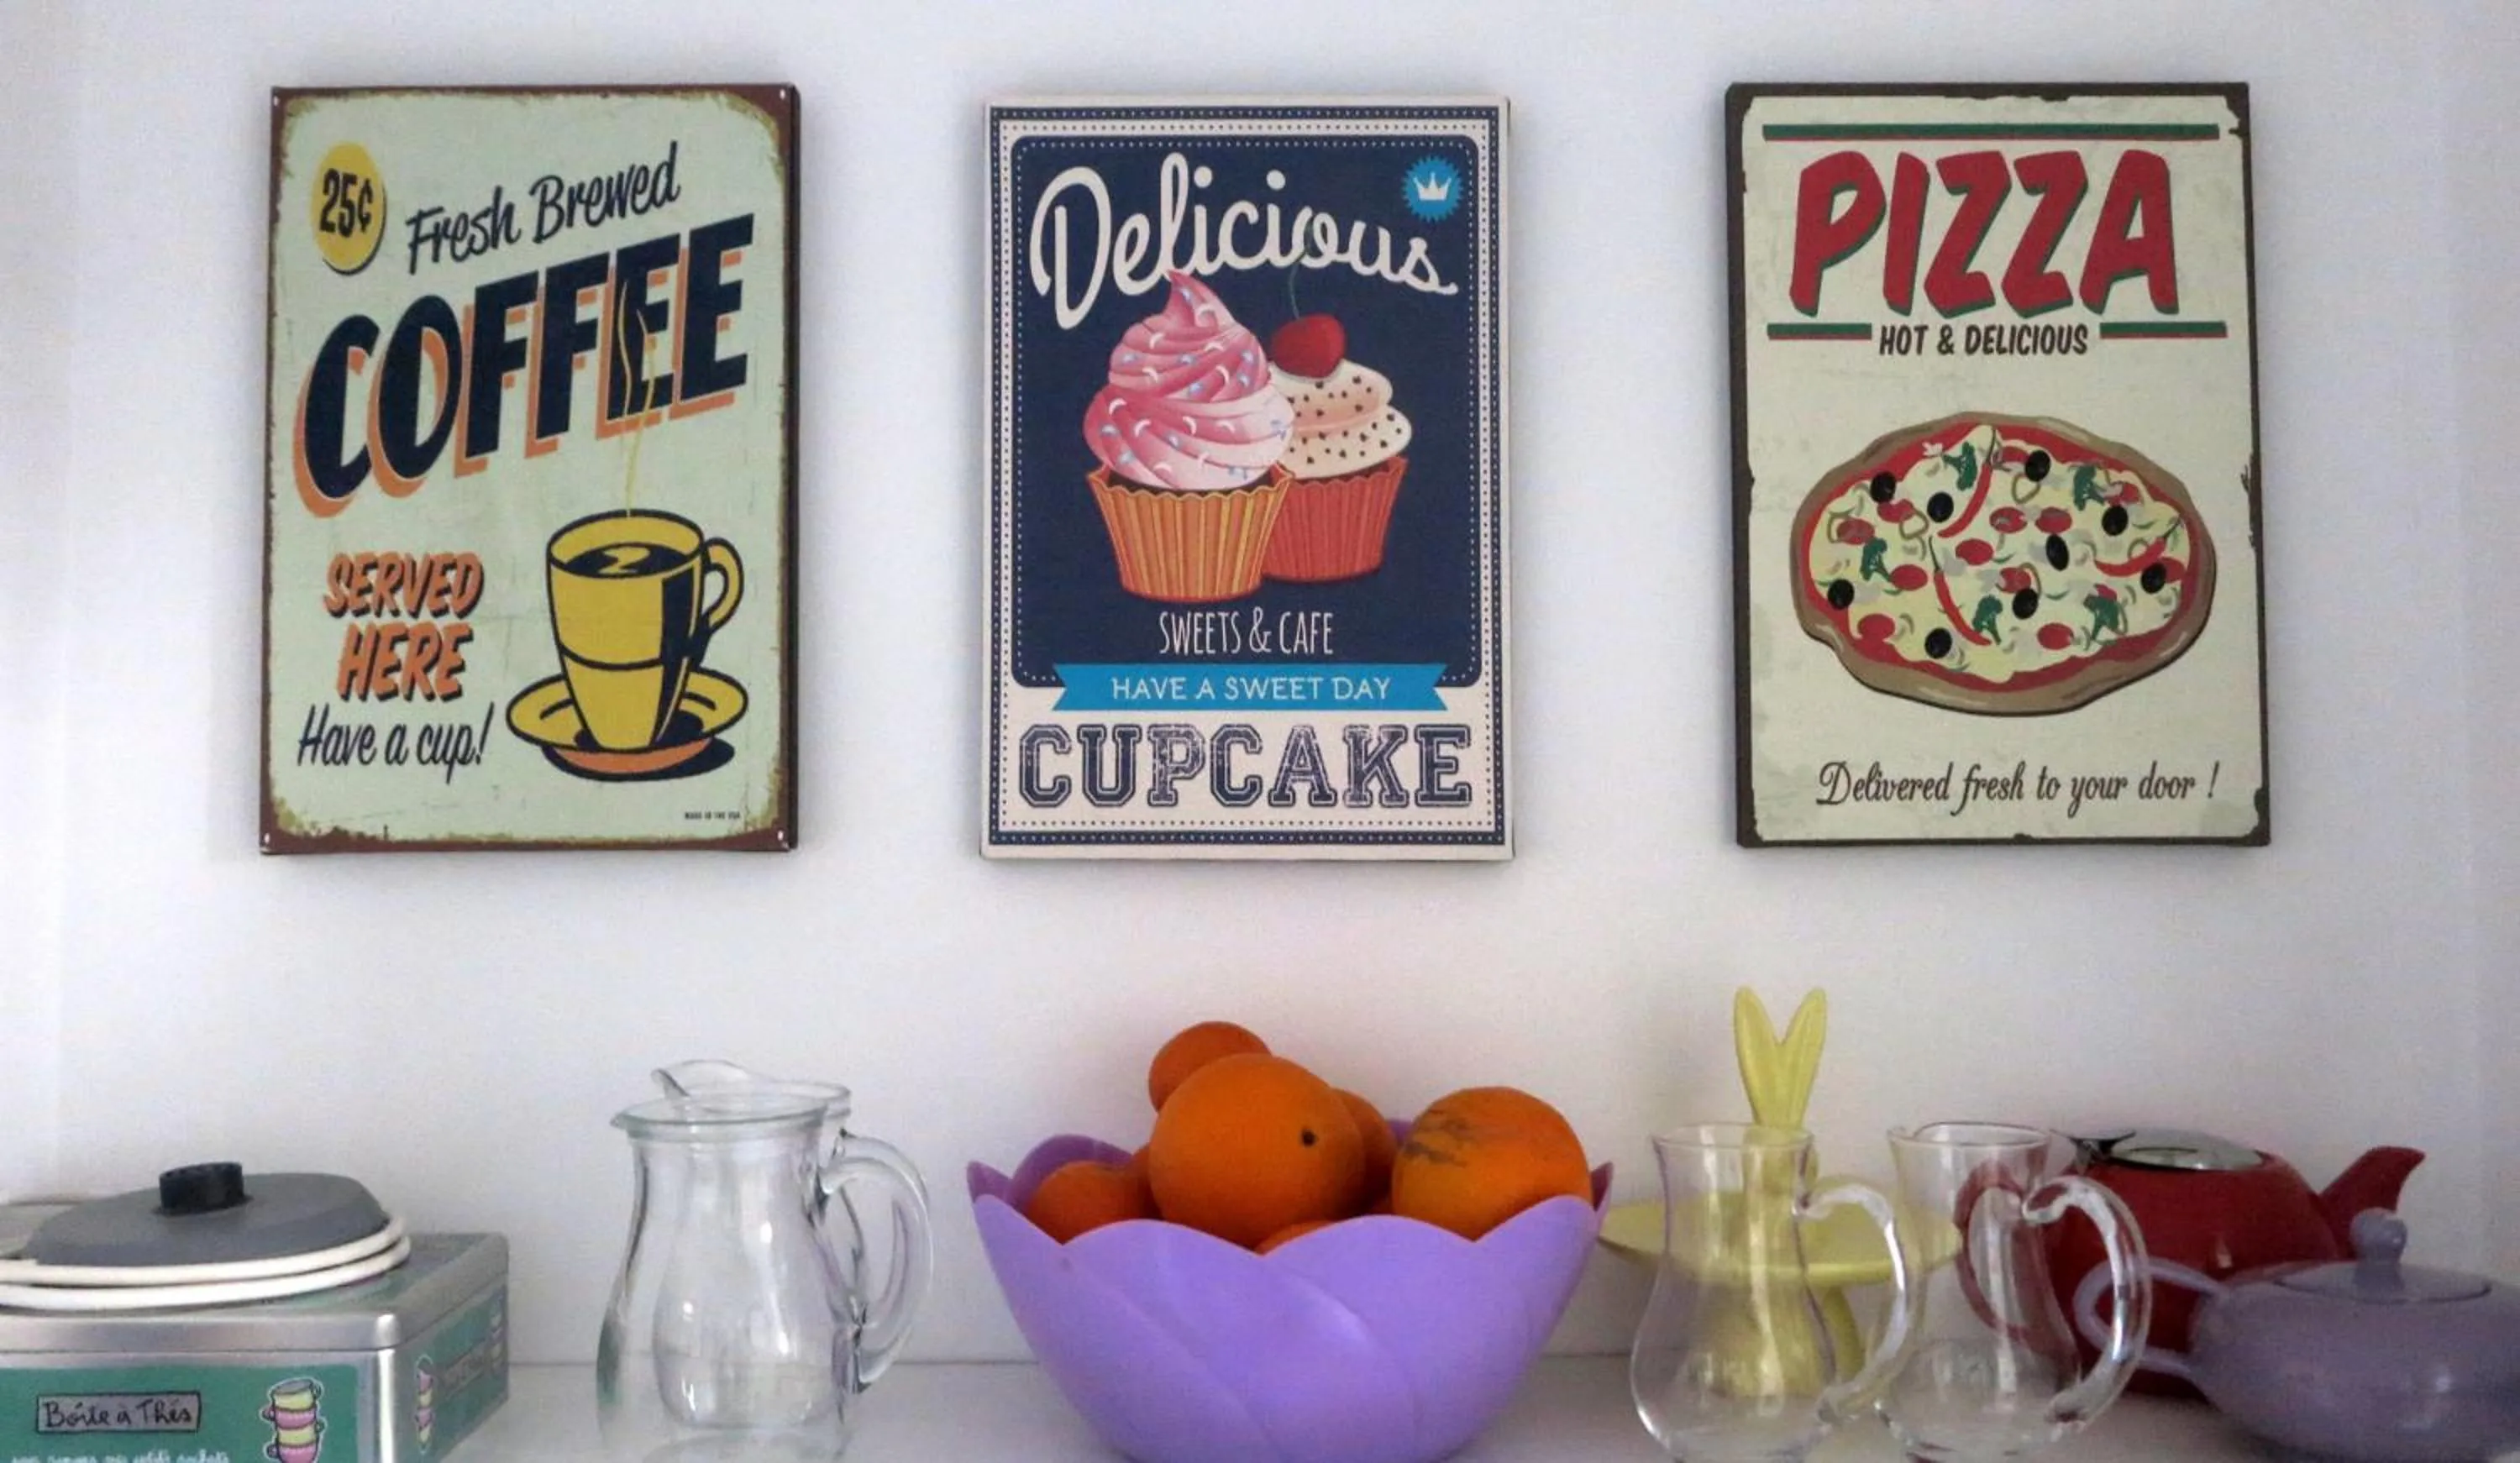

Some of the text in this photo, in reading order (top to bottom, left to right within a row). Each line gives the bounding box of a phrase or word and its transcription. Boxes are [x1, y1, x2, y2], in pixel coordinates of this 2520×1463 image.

[407, 140, 681, 275] Fresh Brewed
[1029, 151, 1458, 329] Delicious
[1789, 149, 2179, 318] PIZZA
[294, 213, 754, 518] COFFEE
[1879, 324, 2088, 356] HOT & DELICIOUS
[323, 552, 484, 619] SERVED
[335, 621, 474, 702] HERE
[1158, 606, 1334, 655] SWEETS & CAFE
[1111, 678, 1391, 700] HAVE A SWEET DAY
[297, 701, 495, 785] Have a cup!
[1019, 724, 1473, 809] CUPCAKE
[1815, 760, 1953, 805] Delivered
[1950, 761, 2024, 815] fresh
[2036, 766, 2061, 800] to
[2070, 773, 2127, 818] your
[2138, 761, 2197, 800] door
